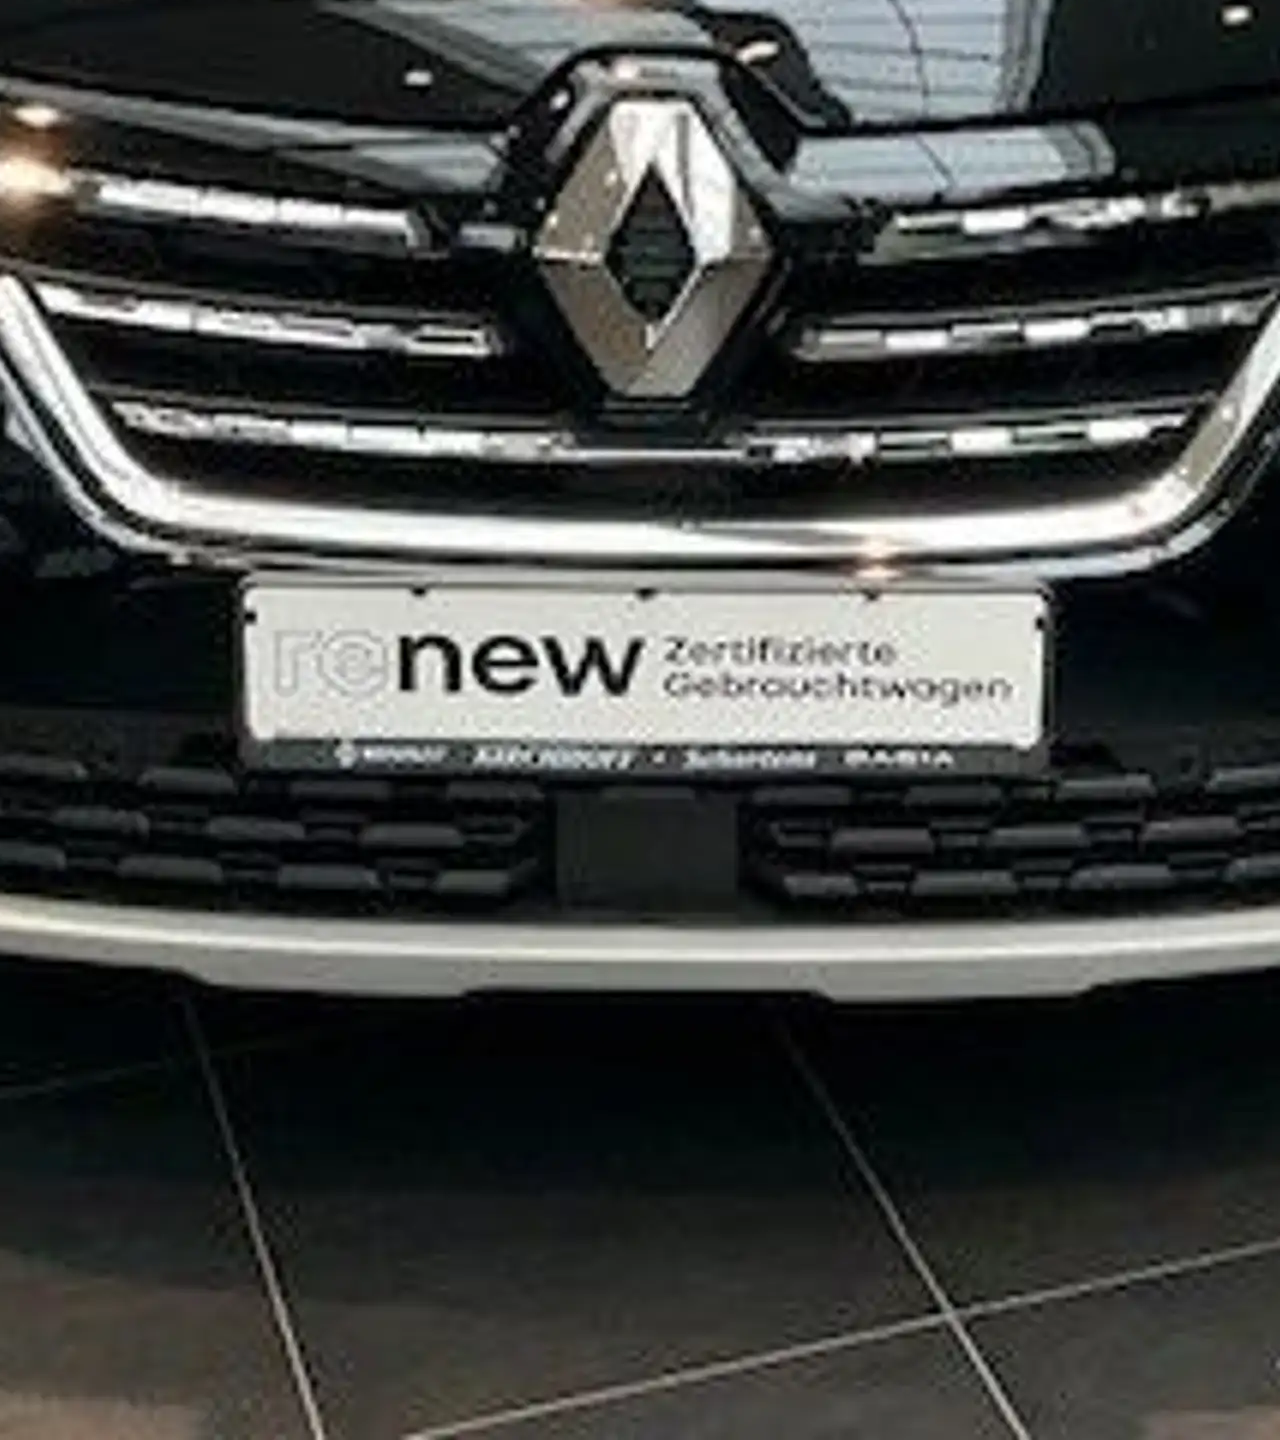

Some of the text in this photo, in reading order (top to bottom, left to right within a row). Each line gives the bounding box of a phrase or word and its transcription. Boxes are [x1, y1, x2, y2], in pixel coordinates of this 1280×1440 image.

[272, 629, 645, 697] renew
[665, 636, 896, 666] Zertifizierte
[663, 673, 1014, 707] Gebrauchtwagen
